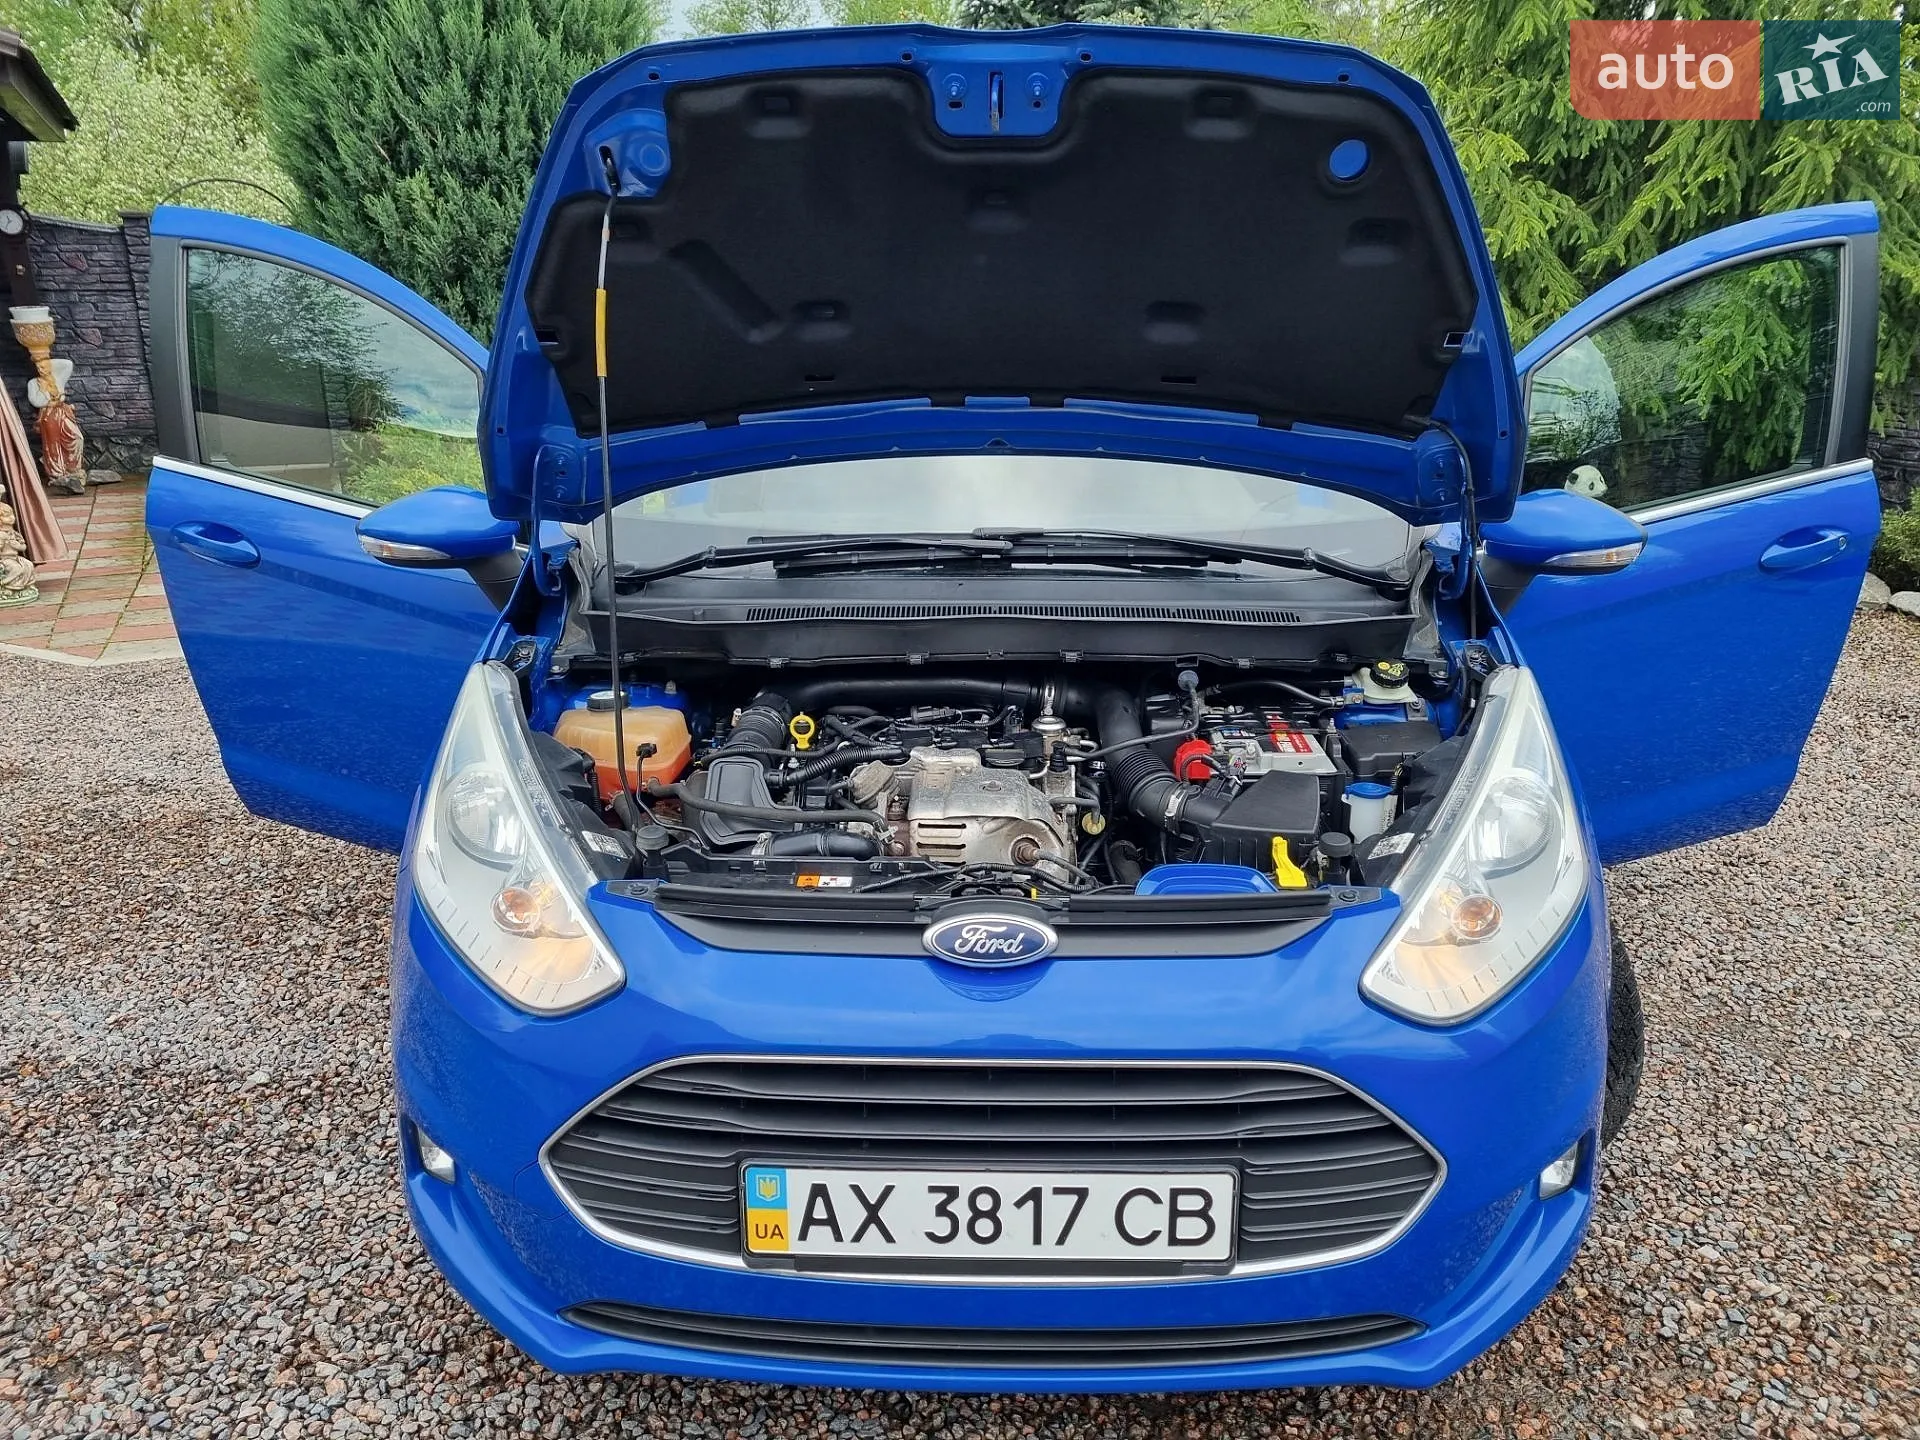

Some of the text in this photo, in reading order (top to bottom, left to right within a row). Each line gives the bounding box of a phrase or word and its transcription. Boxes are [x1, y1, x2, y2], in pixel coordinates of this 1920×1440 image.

[954, 924, 1024, 954] Ford
[797, 1183, 1216, 1246] AX 3817 CB
[755, 1223, 784, 1240] UA
